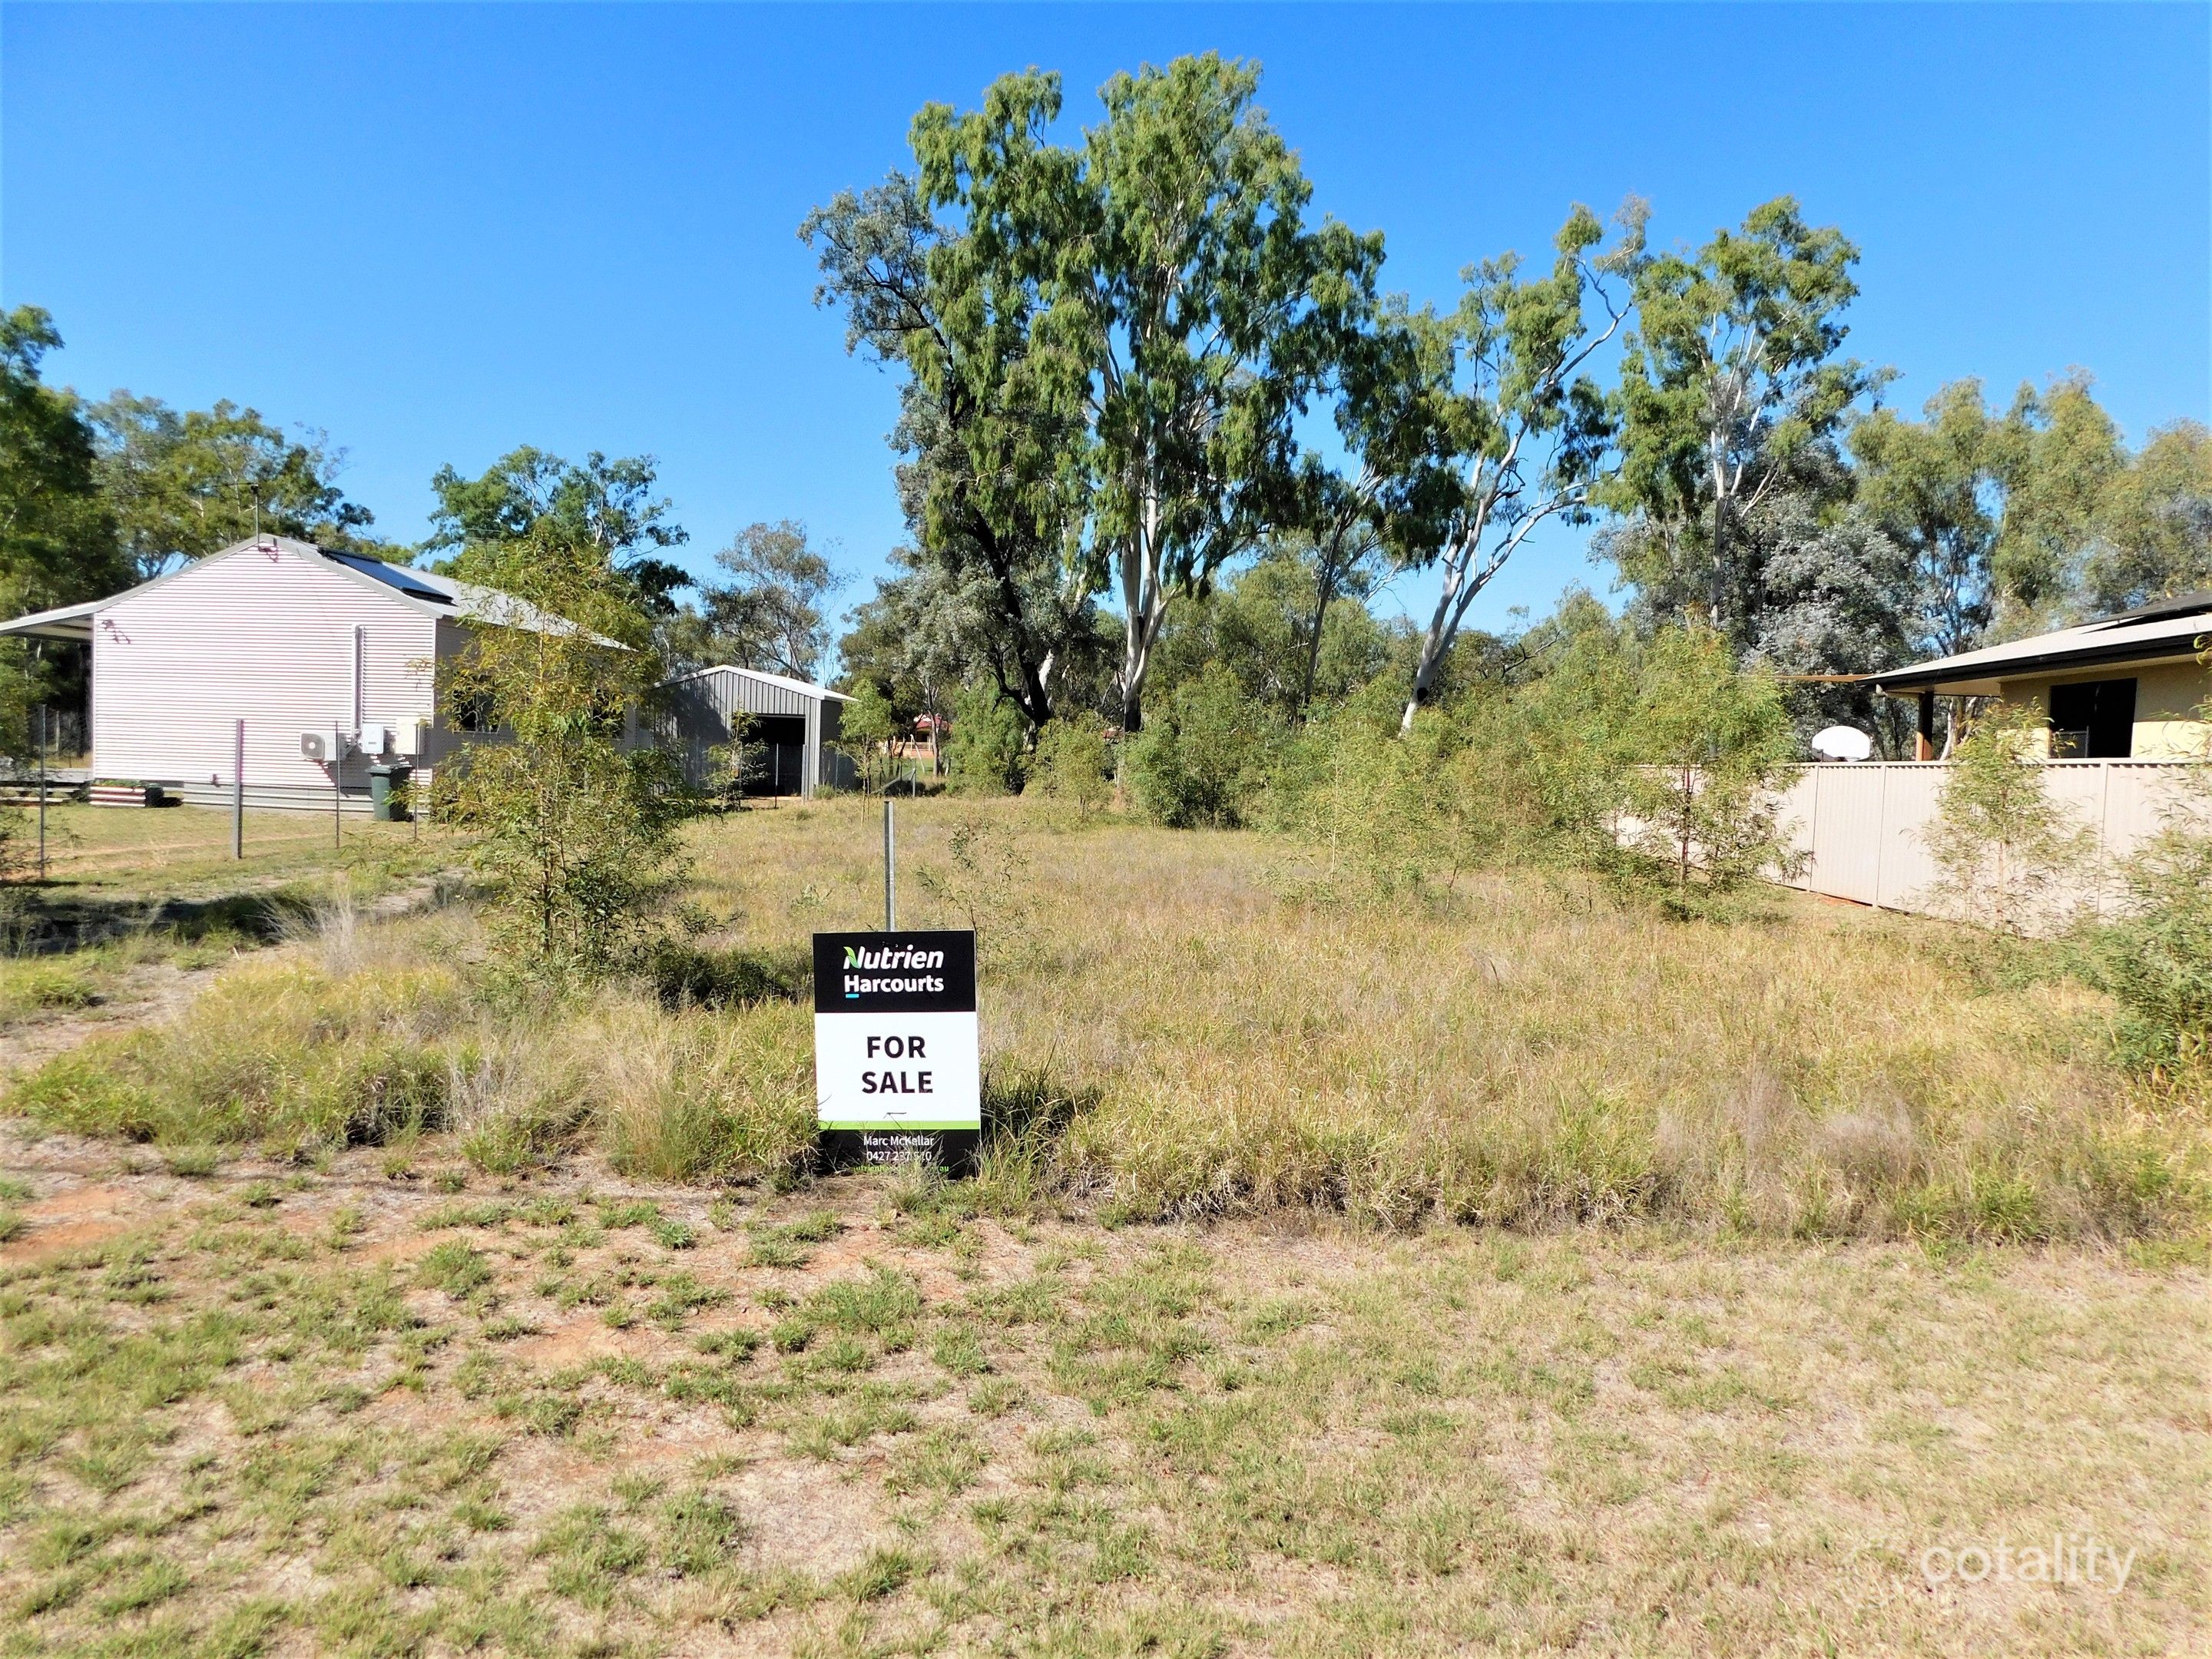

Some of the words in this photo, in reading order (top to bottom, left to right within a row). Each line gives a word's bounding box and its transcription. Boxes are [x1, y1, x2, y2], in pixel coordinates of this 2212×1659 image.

[843, 944, 943, 969] Nutrien
[844, 975, 944, 993] Harcourts
[867, 1036, 926, 1058] FOR
[862, 1071, 933, 1094] SALE
[863, 1135, 888, 1146] Marc
[890, 1135, 934, 1146] McKellar
[866, 1151, 890, 1161] 0427
